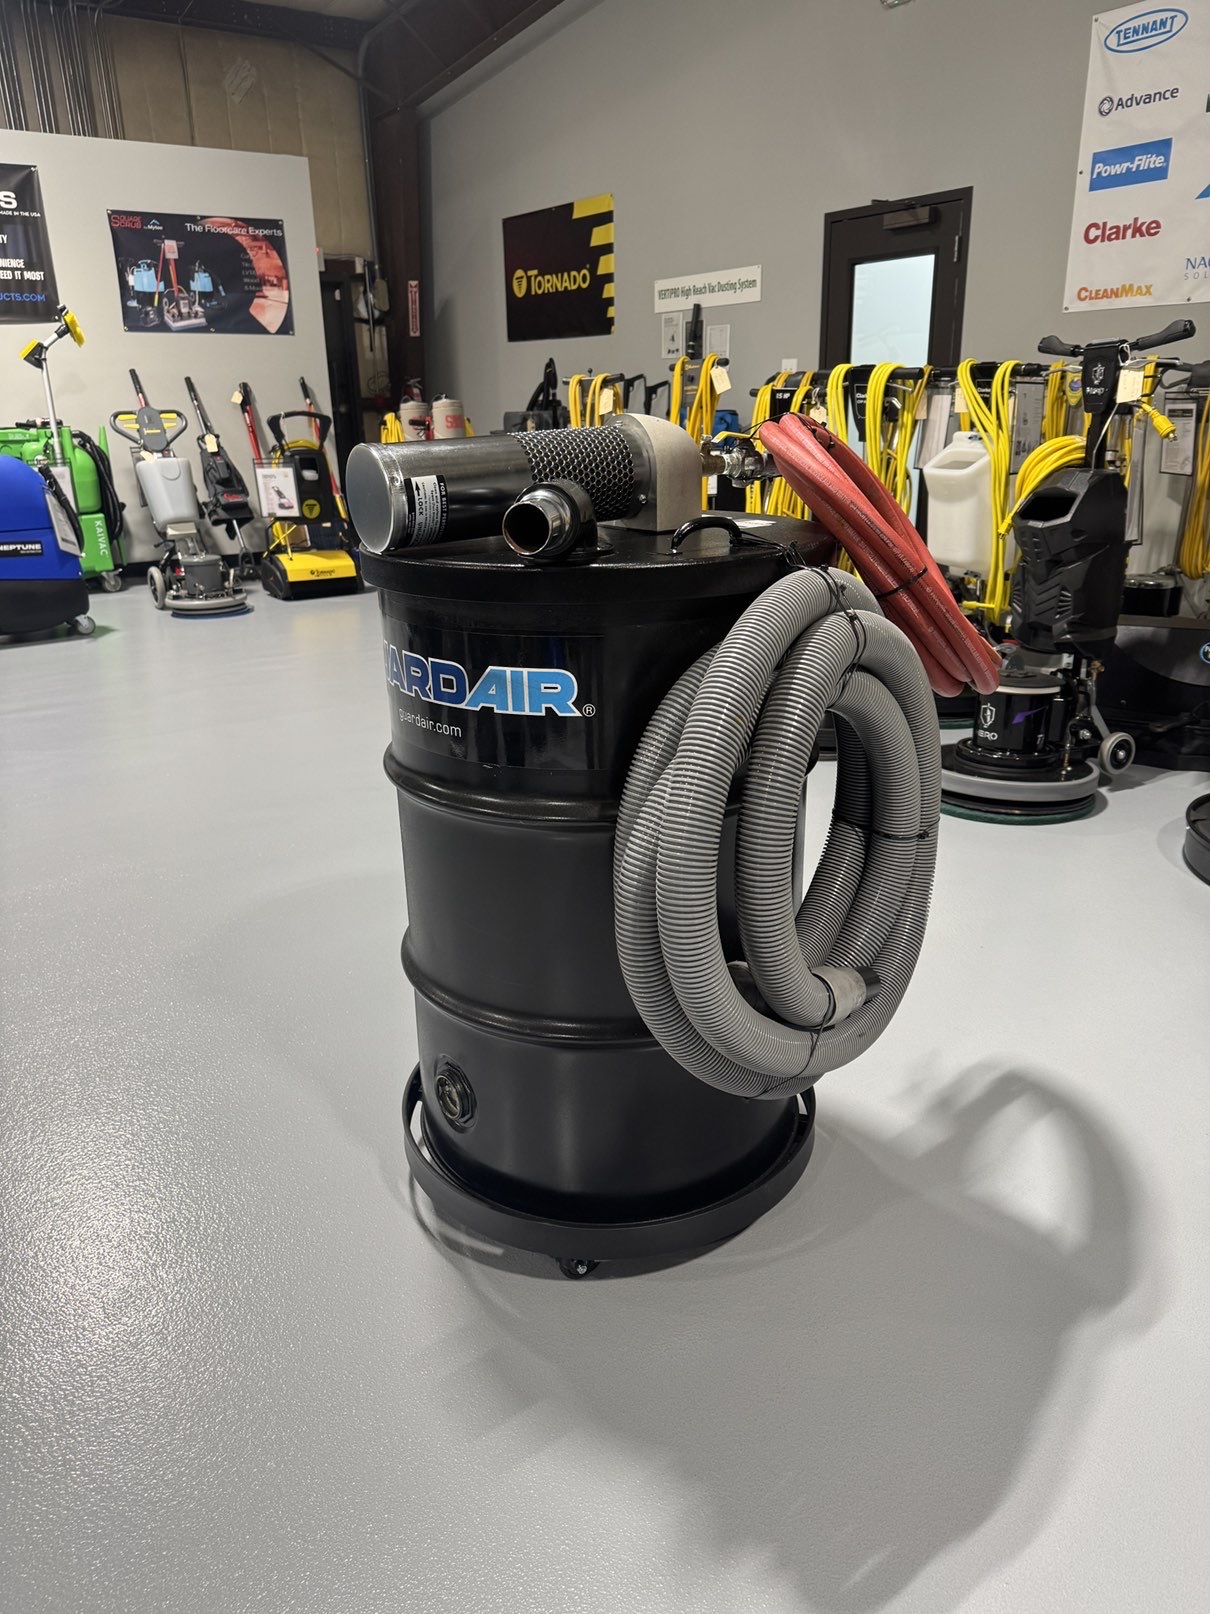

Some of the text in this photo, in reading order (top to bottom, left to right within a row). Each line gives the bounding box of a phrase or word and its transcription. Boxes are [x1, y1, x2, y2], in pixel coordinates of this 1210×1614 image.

[1115, 15, 1178, 47] TENNANT
[1115, 87, 1179, 111] Advance
[1092, 154, 1166, 179] Powr-Flite
[0, 234, 8, 243] TY
[185, 223, 283, 237] The Floorcare Experts
[1083, 217, 1162, 245] Clarke
[1185, 256, 1210, 270] NA
[0, 271, 44, 280] EED IT MOST
[527, 268, 590, 295] TORNADO
[658, 278, 757, 300] VERTIPRO High Reach Vac Dusting System
[95, 520, 108, 556] KAIVAC
[400, 708, 462, 737] guardair.com
[978, 729, 998, 741] ERO
